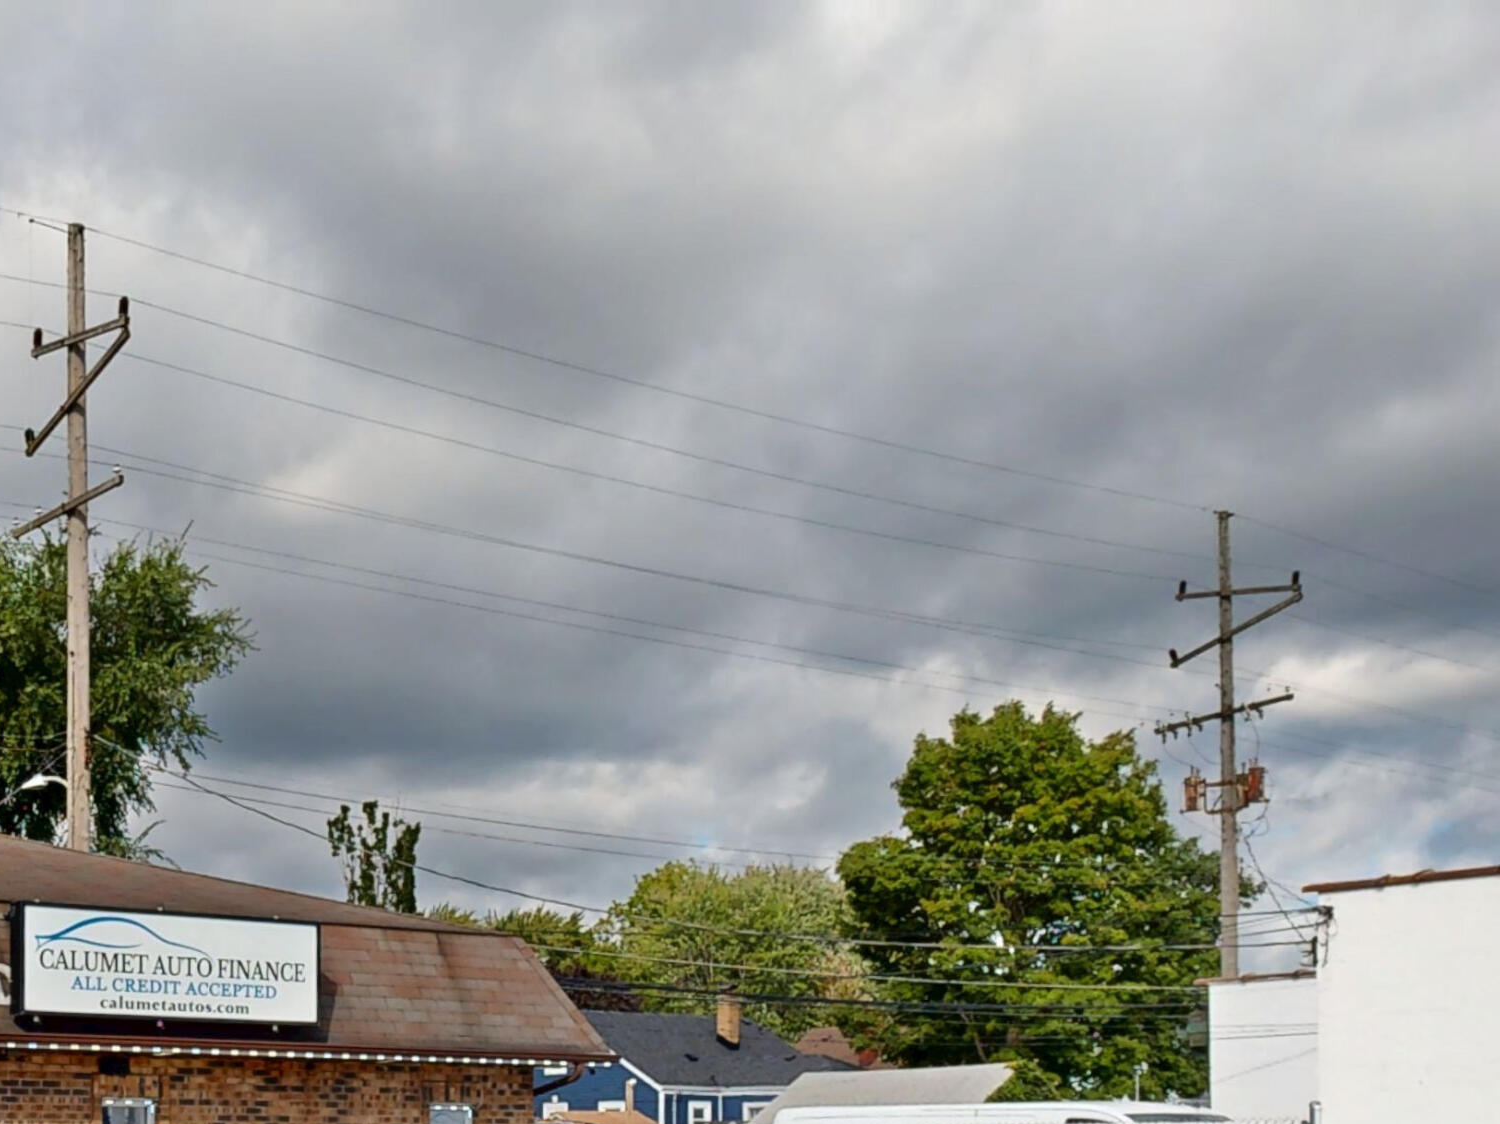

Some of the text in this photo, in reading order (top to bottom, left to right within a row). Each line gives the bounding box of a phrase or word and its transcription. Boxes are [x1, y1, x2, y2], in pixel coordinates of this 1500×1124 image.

[39, 948, 306, 983] CALUMET AUTO FINANCE
[71, 975, 277, 999] ALL CREDIT ACCEPTED
[100, 995, 249, 1014] calumetautos.com
